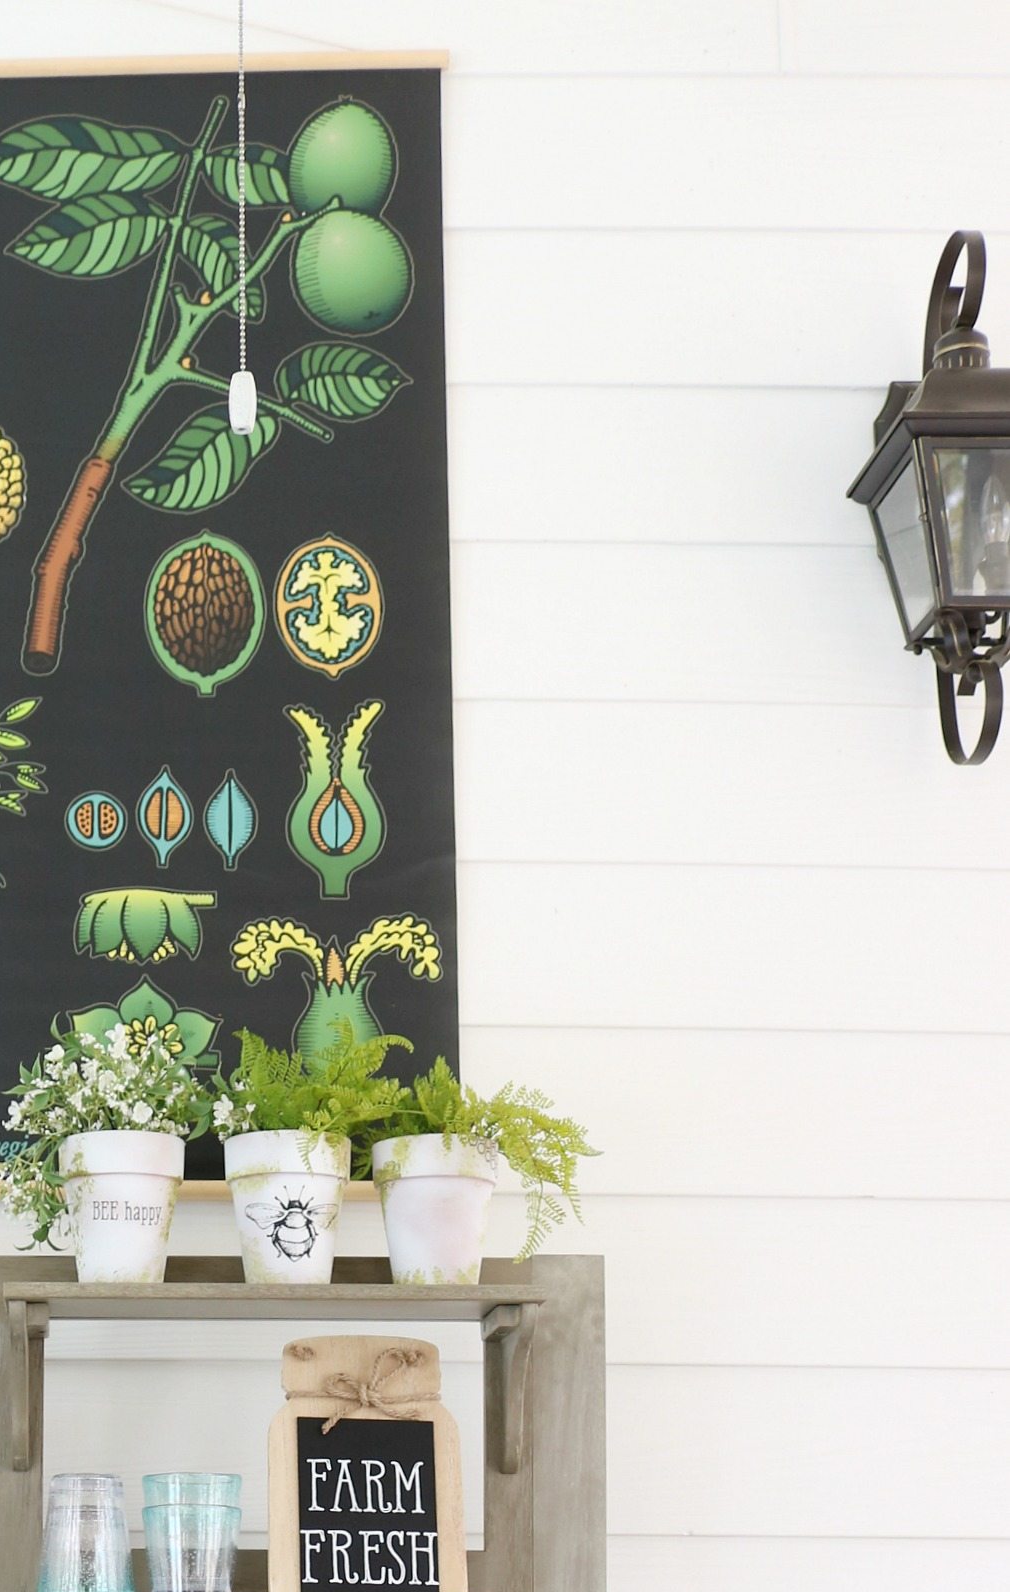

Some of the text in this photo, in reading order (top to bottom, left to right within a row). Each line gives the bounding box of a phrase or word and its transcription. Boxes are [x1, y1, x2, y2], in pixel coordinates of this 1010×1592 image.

[93, 1200, 119, 1220] BEE
[306, 1458, 425, 1514] FARM
[300, 1529, 440, 1586] FRESH
